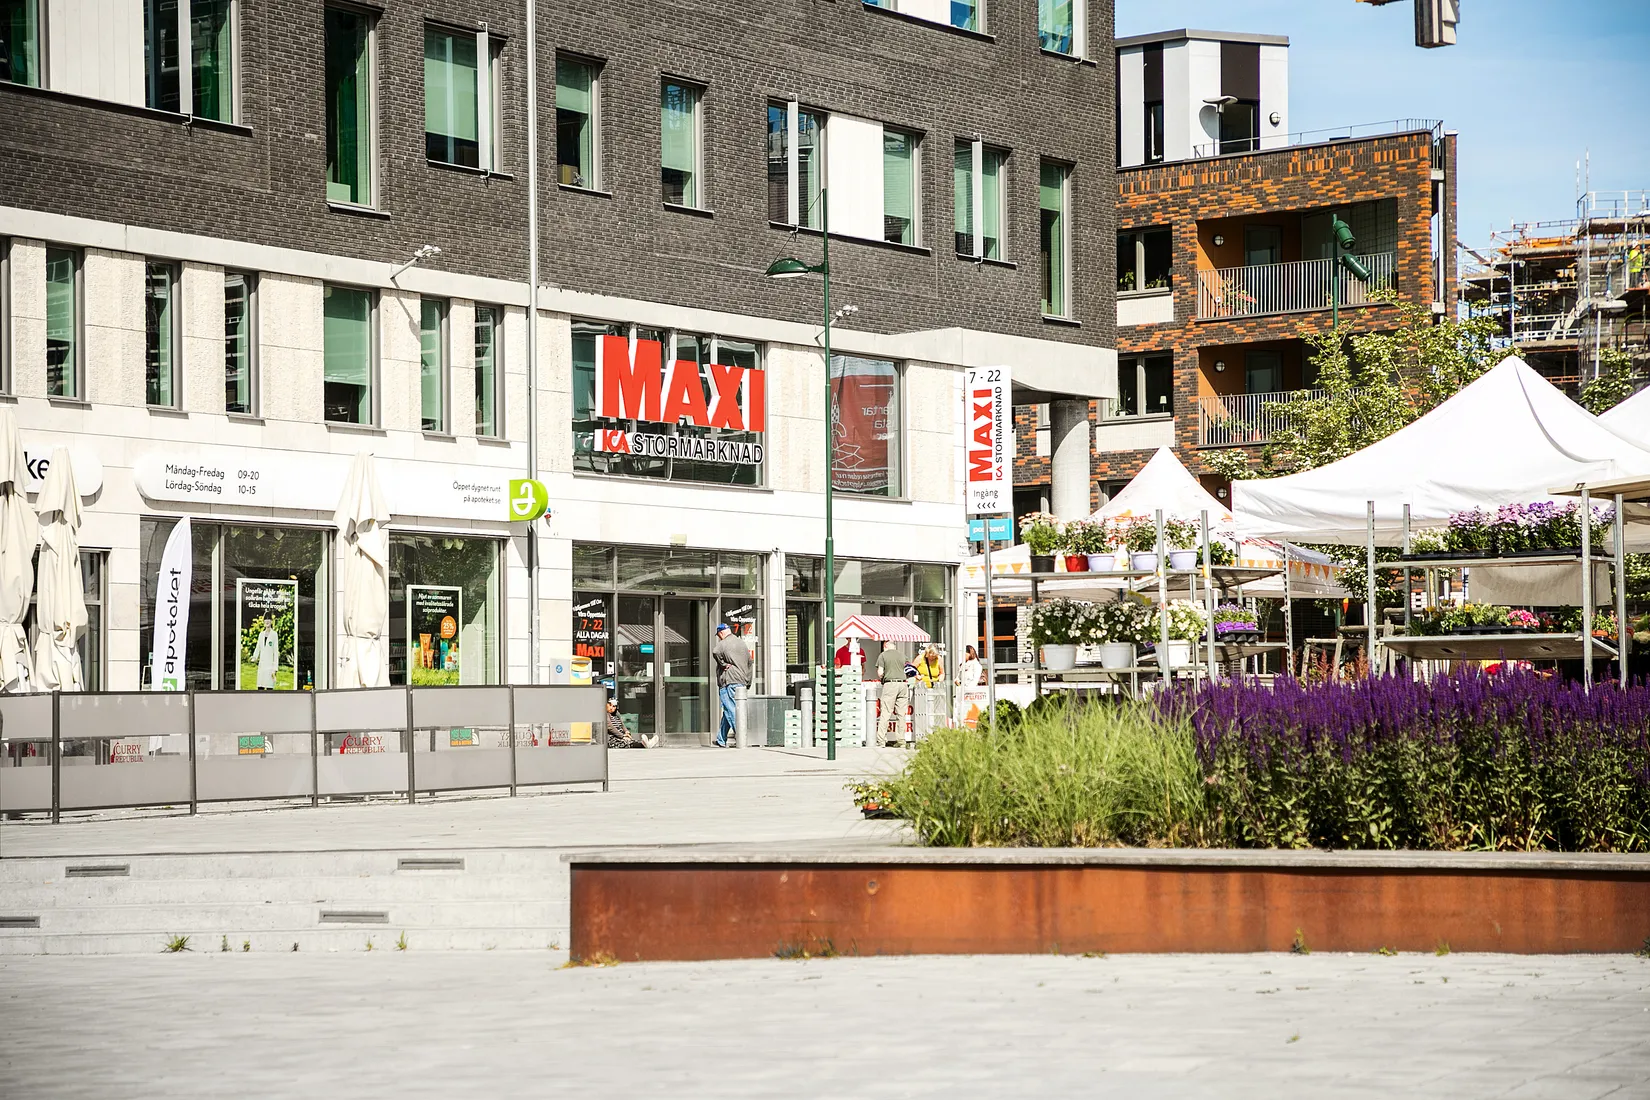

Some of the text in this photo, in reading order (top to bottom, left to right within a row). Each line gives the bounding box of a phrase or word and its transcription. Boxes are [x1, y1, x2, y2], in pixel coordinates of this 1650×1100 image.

[969, 372, 976, 383] 7
[987, 370, 1001, 382] 22
[597, 335, 764, 432] MAXI
[969, 389, 993, 482] MAXI
[995, 386, 1003, 481] ICA STORMARKNAD
[598, 429, 764, 465] ICA STORMARKNAD
[165, 464, 260, 480] Måndag-Fredag 09-20
[165, 479, 257, 495] Lördag-Söndag 10-15
[453, 480, 471, 491] Öppet
[471, 483, 489, 492] dygnet
[464, 495, 501, 504] på apoteket.se
[974, 489, 999, 501] Ingång
[165, 568, 181, 674] apoteket
[582, 619, 588, 630] 7
[593, 619, 603, 630] 22
[733, 623, 740, 634] 7
[591, 631, 609, 639] DAGAR
[576, 644, 605, 657] MAXI
[347, 736, 383, 747] CURRY
[115, 744, 141, 754] CURRY
[346, 746, 386, 755] REPUBLIK
[115, 755, 143, 763] REPUBLIK
